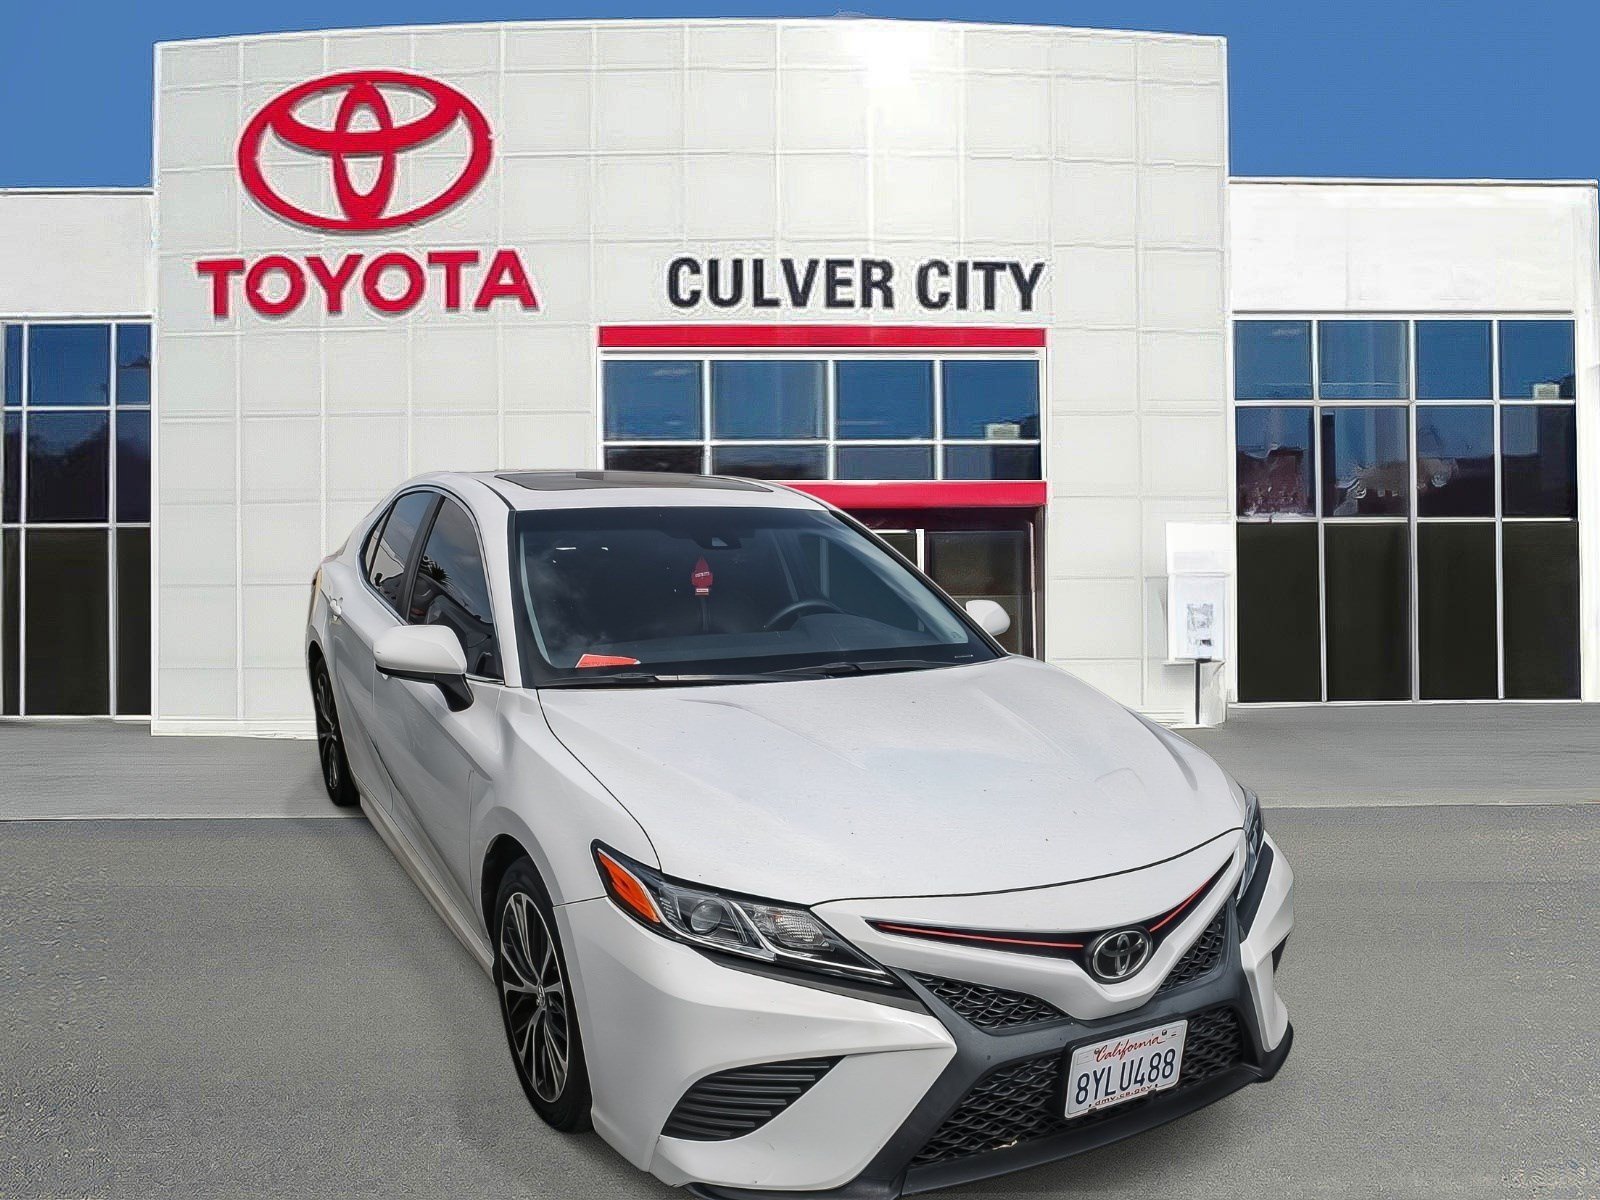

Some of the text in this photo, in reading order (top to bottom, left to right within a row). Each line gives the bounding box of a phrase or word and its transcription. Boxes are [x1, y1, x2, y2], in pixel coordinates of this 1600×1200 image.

[195, 249, 539, 319] TOYOTA
[667, 257, 1046, 311] CULVER CITY
[1096, 1033, 1166, 1062] California
[1075, 1048, 1176, 1105] 8YLU488
